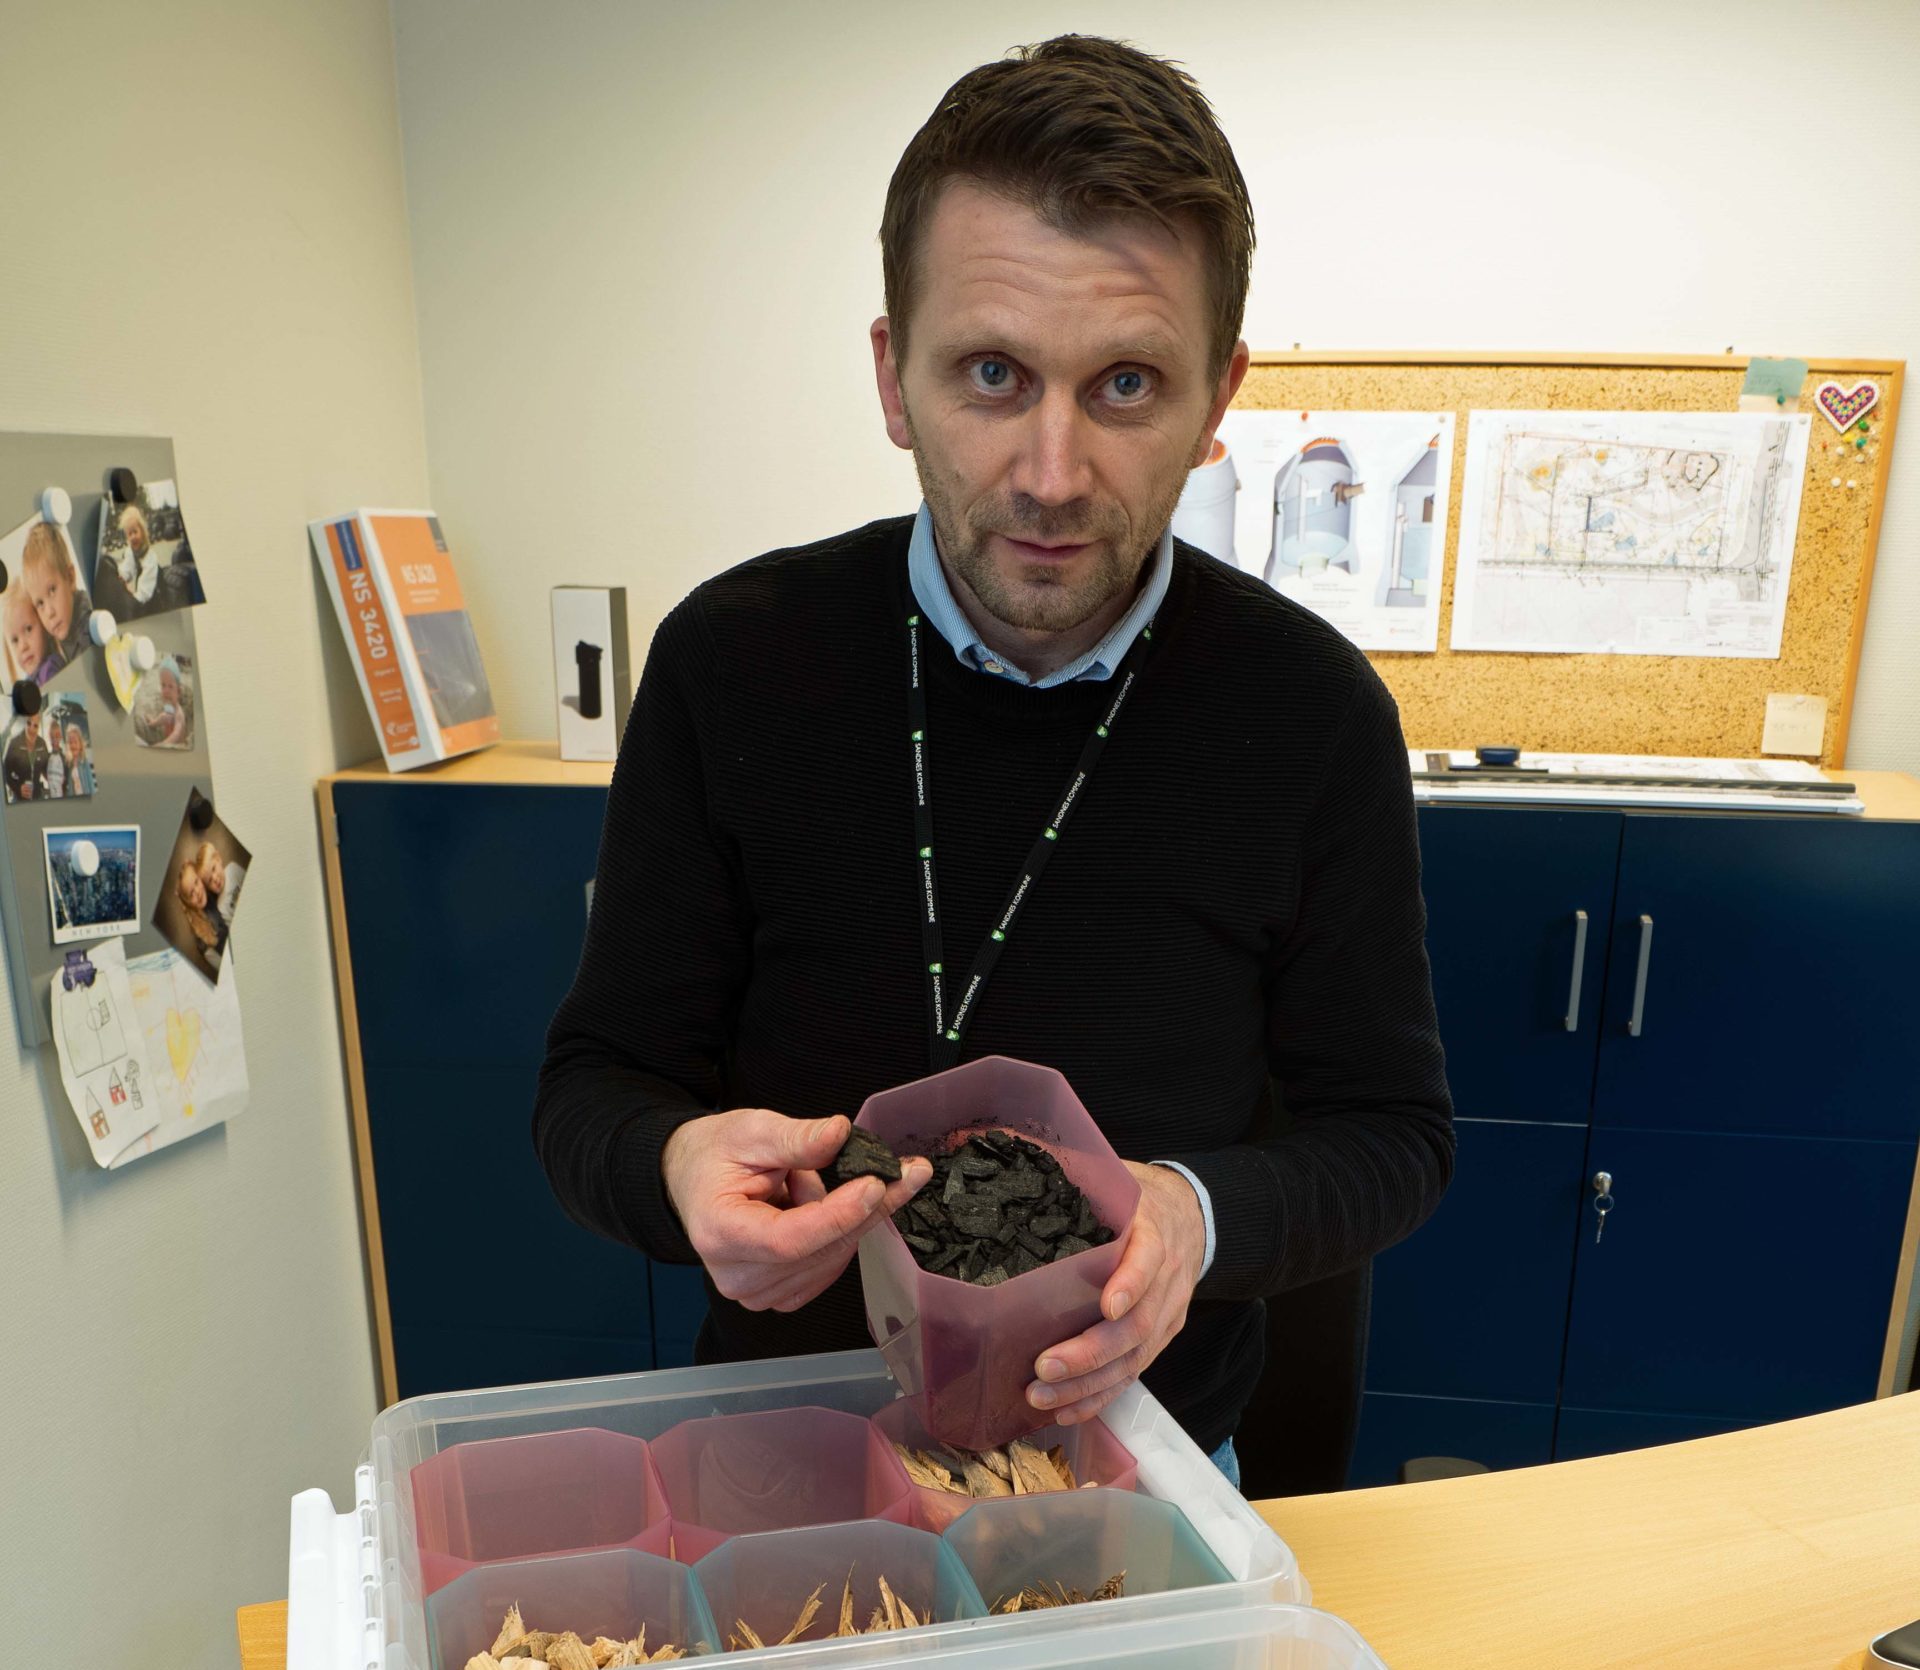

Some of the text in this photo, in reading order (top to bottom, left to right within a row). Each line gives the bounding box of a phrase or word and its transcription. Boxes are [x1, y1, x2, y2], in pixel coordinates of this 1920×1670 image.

[349, 572, 372, 604] NS
[360, 606, 388, 659] 3420
[910, 627, 918, 656] SANDNES
[914, 742, 925, 806] SANDNES KOMMUNE
[1052, 771, 1086, 829] SANDNES KOMMUNE
[923, 859, 936, 923] SANDNES KOMMUNE
[999, 874, 1032, 930] SANDNES KOMMUNE
[72, 923, 121, 937] NEW YORK
[933, 975, 943, 1035] SANDNES KOMMUNE
[952, 974, 982, 1030] SANDNES KOMMUNE
